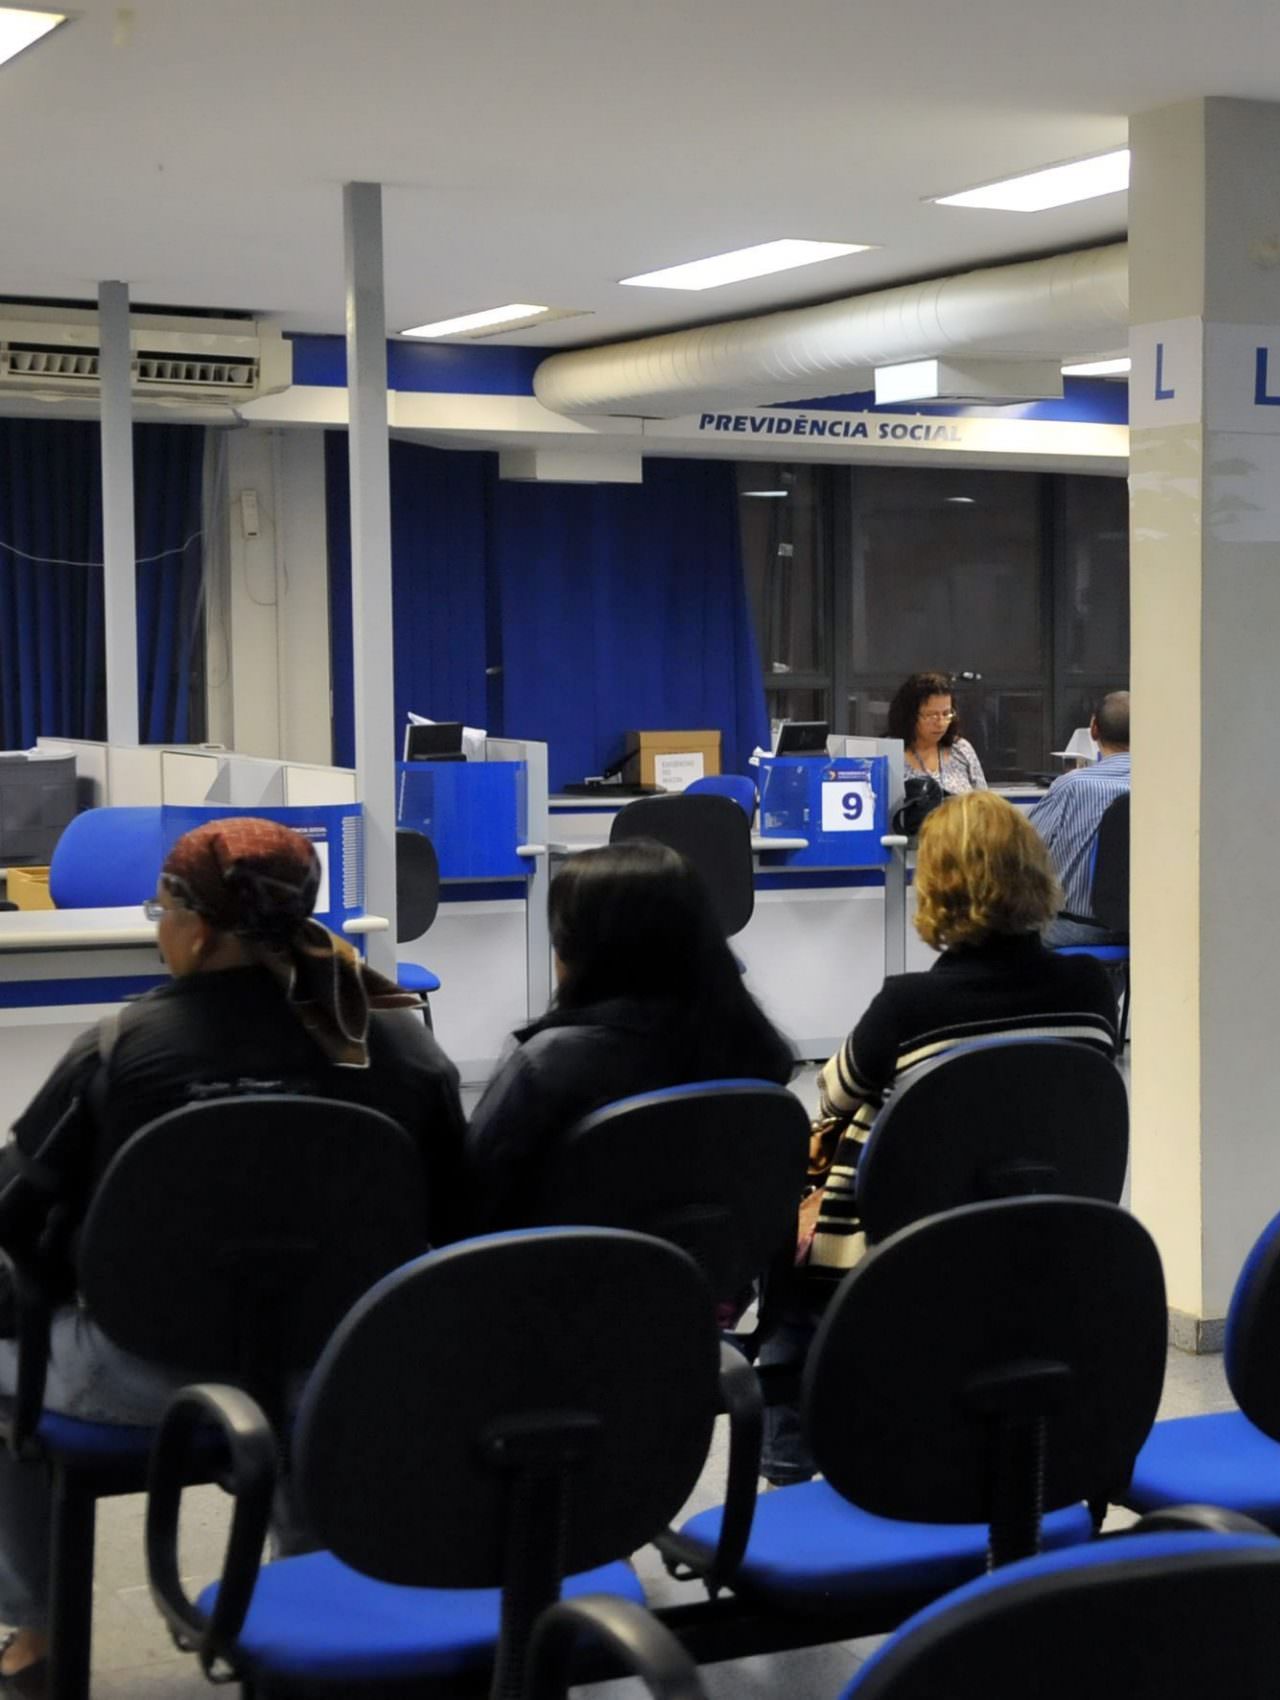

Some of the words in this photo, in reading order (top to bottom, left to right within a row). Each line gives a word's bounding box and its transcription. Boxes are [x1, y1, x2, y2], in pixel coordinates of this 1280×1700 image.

[1155, 343, 1175, 401] L
[699, 413, 868, 438] PREVIDÊNCIA
[878, 422, 962, 441] SOCIAL
[842, 792, 863, 821] 9
